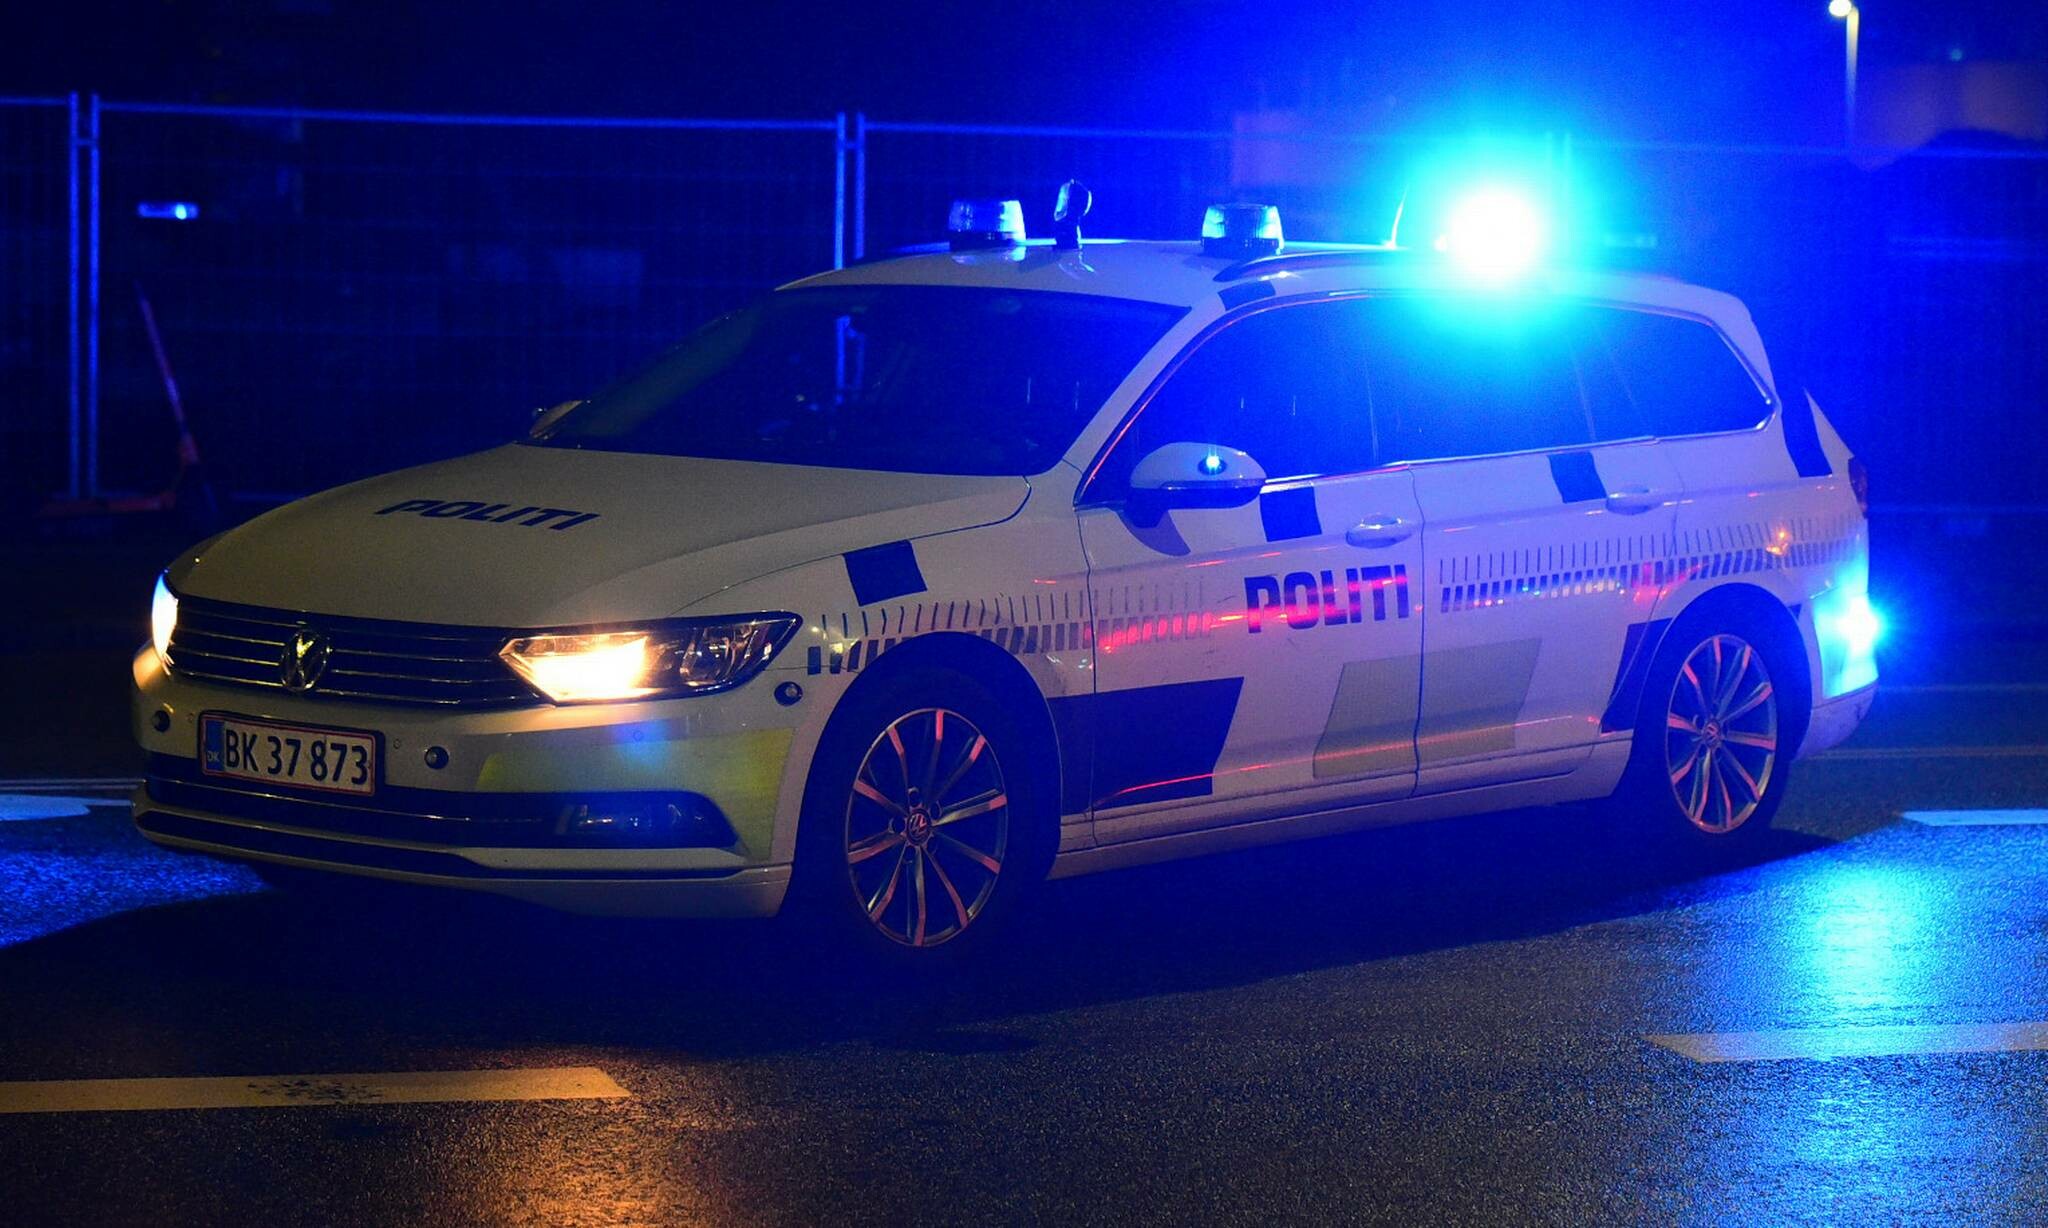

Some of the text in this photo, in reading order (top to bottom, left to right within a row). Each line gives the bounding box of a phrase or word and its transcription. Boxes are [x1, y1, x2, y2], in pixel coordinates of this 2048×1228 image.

[374, 500, 600, 530] POLITI
[1244, 564, 1409, 634] POLITI
[226, 729, 368, 785] BK 37 873
